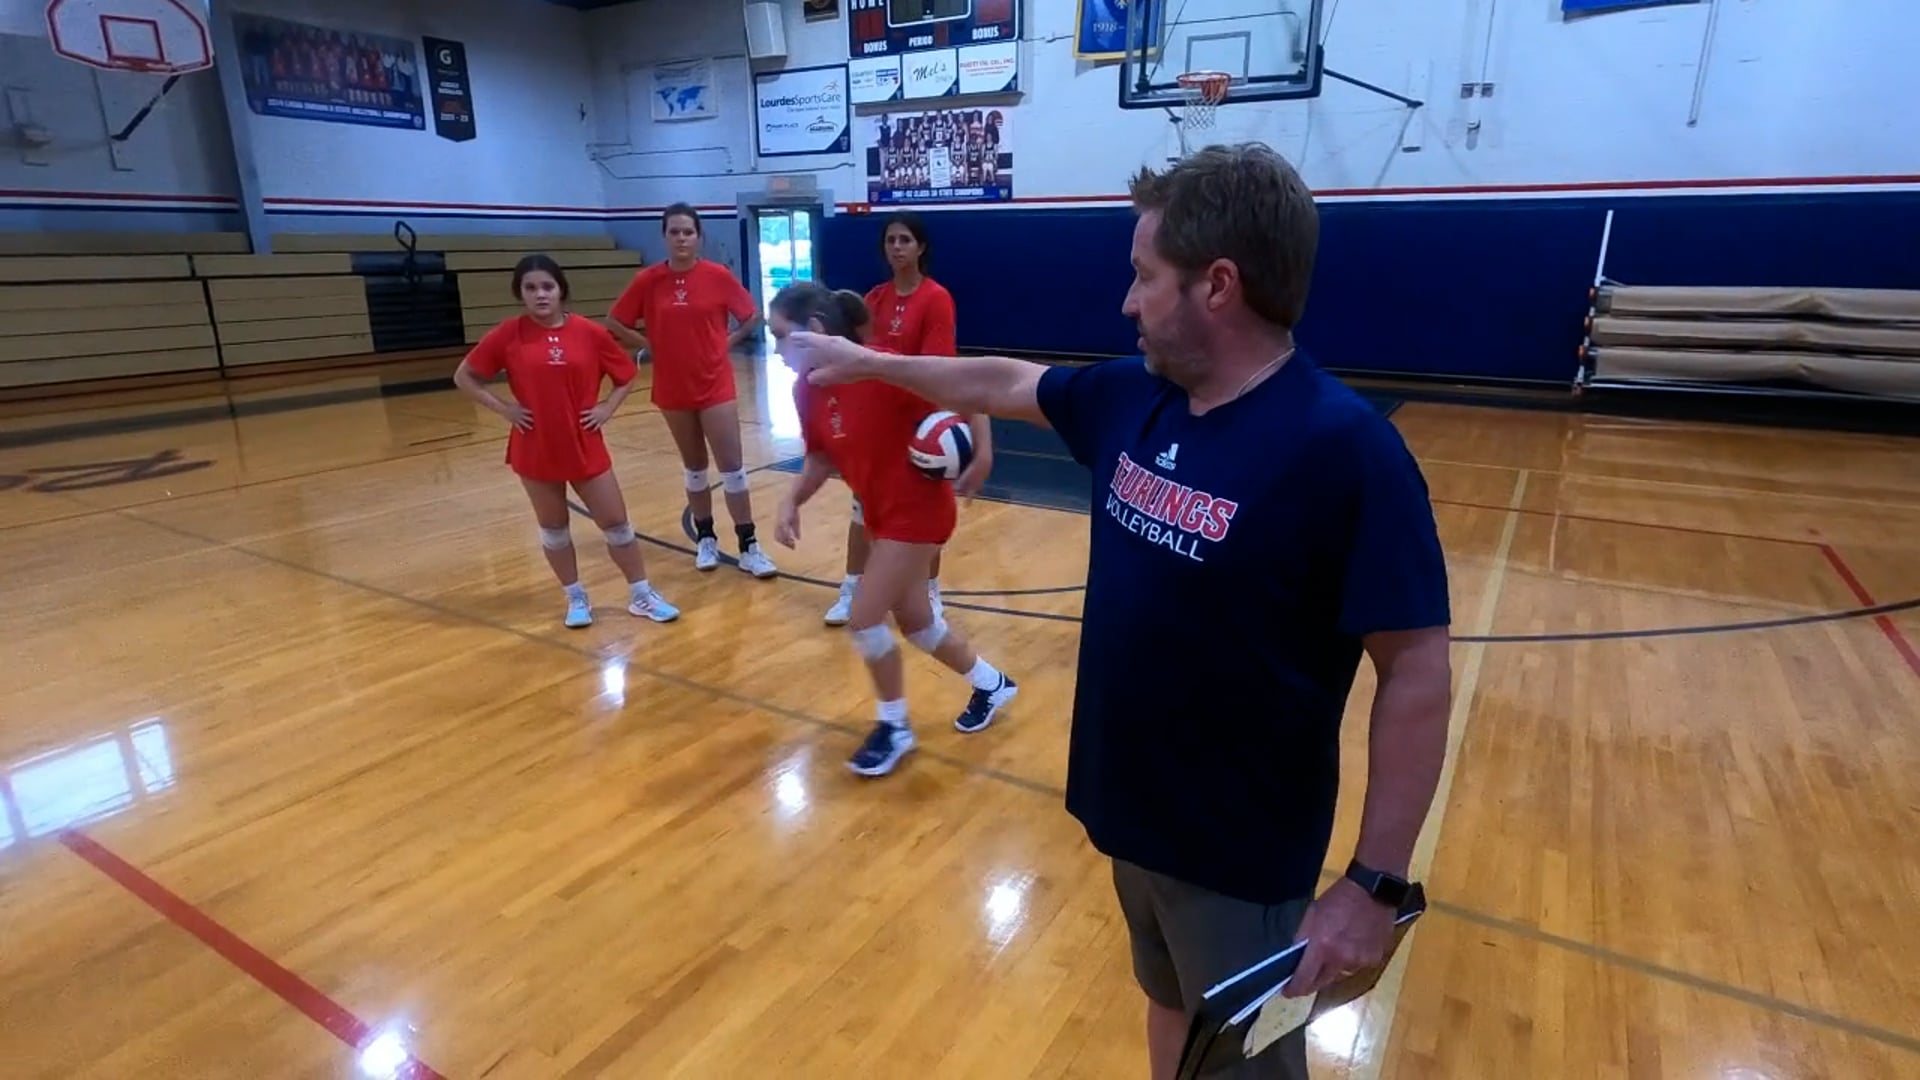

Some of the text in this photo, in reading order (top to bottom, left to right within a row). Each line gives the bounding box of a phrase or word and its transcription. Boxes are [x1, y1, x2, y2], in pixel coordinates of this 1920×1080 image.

[851, 0, 885, 10] HOME
[972, 25, 999, 40] BONUS
[863, 40, 888, 54] BONUS
[908, 35, 933, 47] PERIOD
[439, 49, 452, 65] G
[912, 61, 947, 81] Mel's
[1105, 492, 1205, 562] VOLLEYBALL
